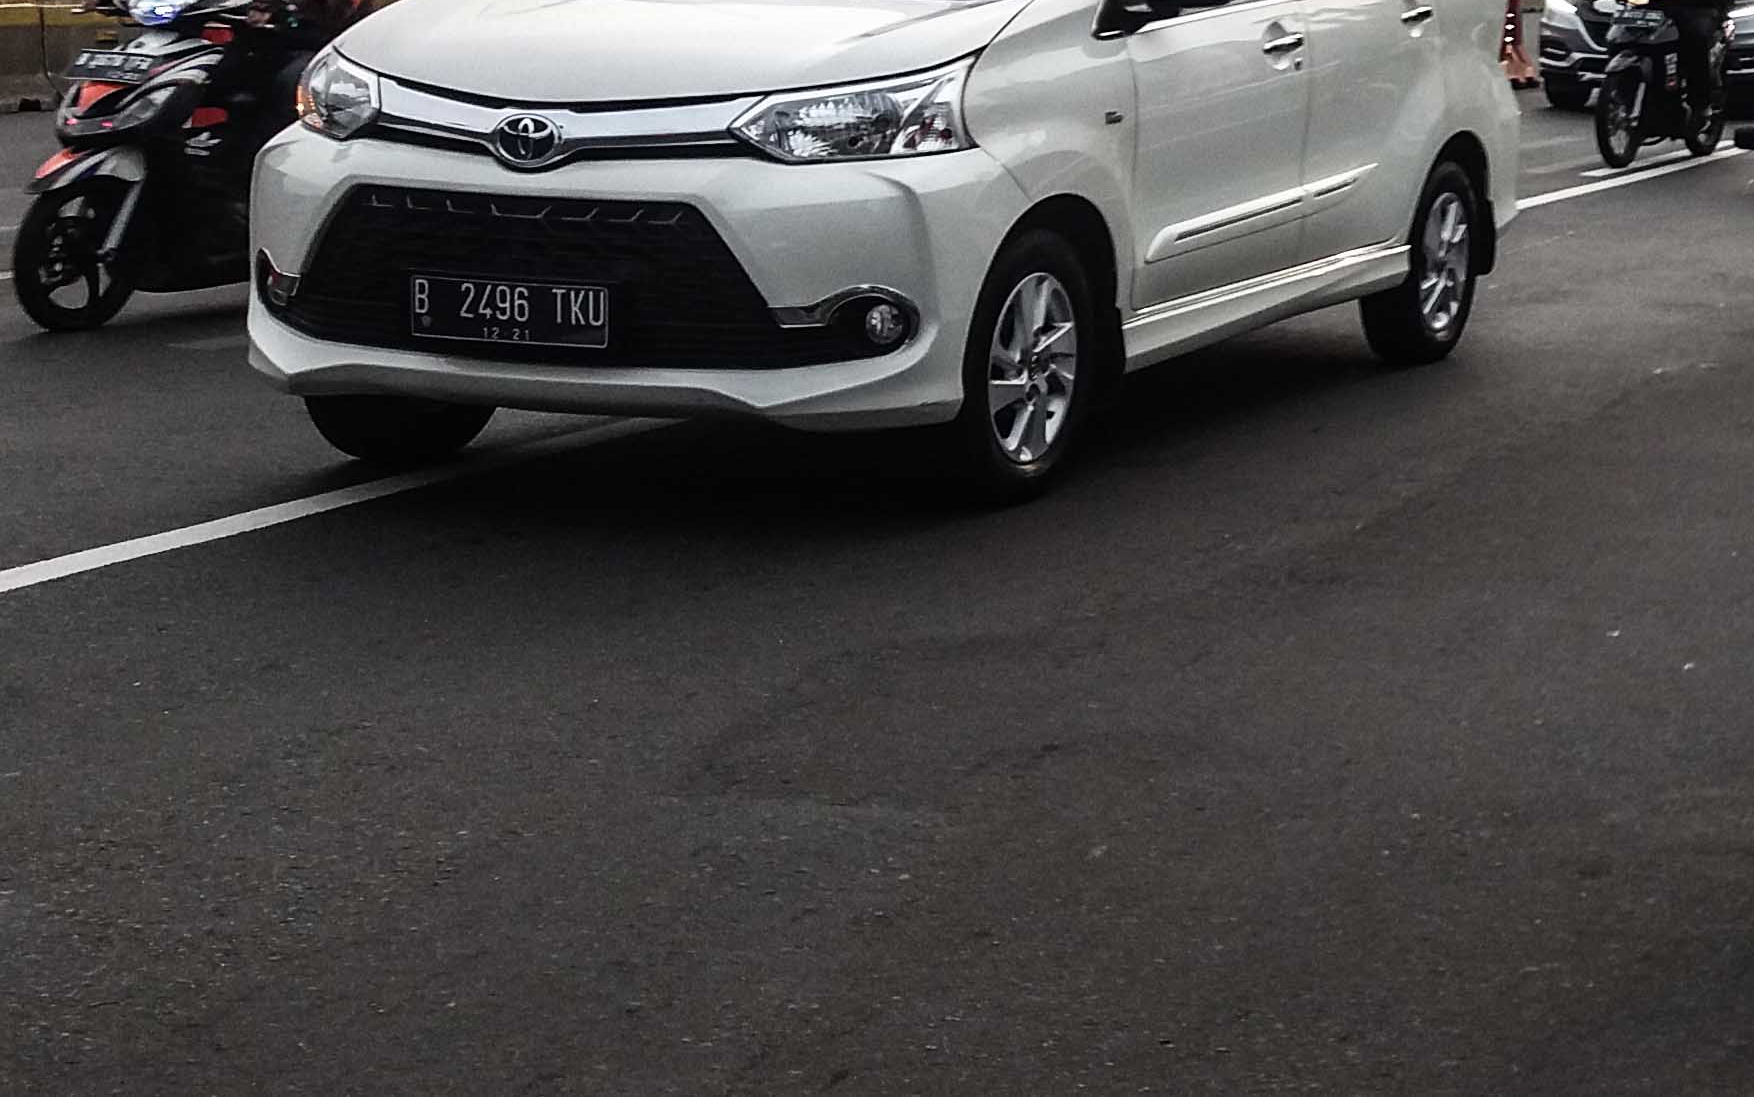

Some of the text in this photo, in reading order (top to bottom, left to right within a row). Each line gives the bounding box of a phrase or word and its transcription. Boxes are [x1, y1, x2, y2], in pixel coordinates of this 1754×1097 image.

[415, 279, 604, 326] B 2496 TKU
